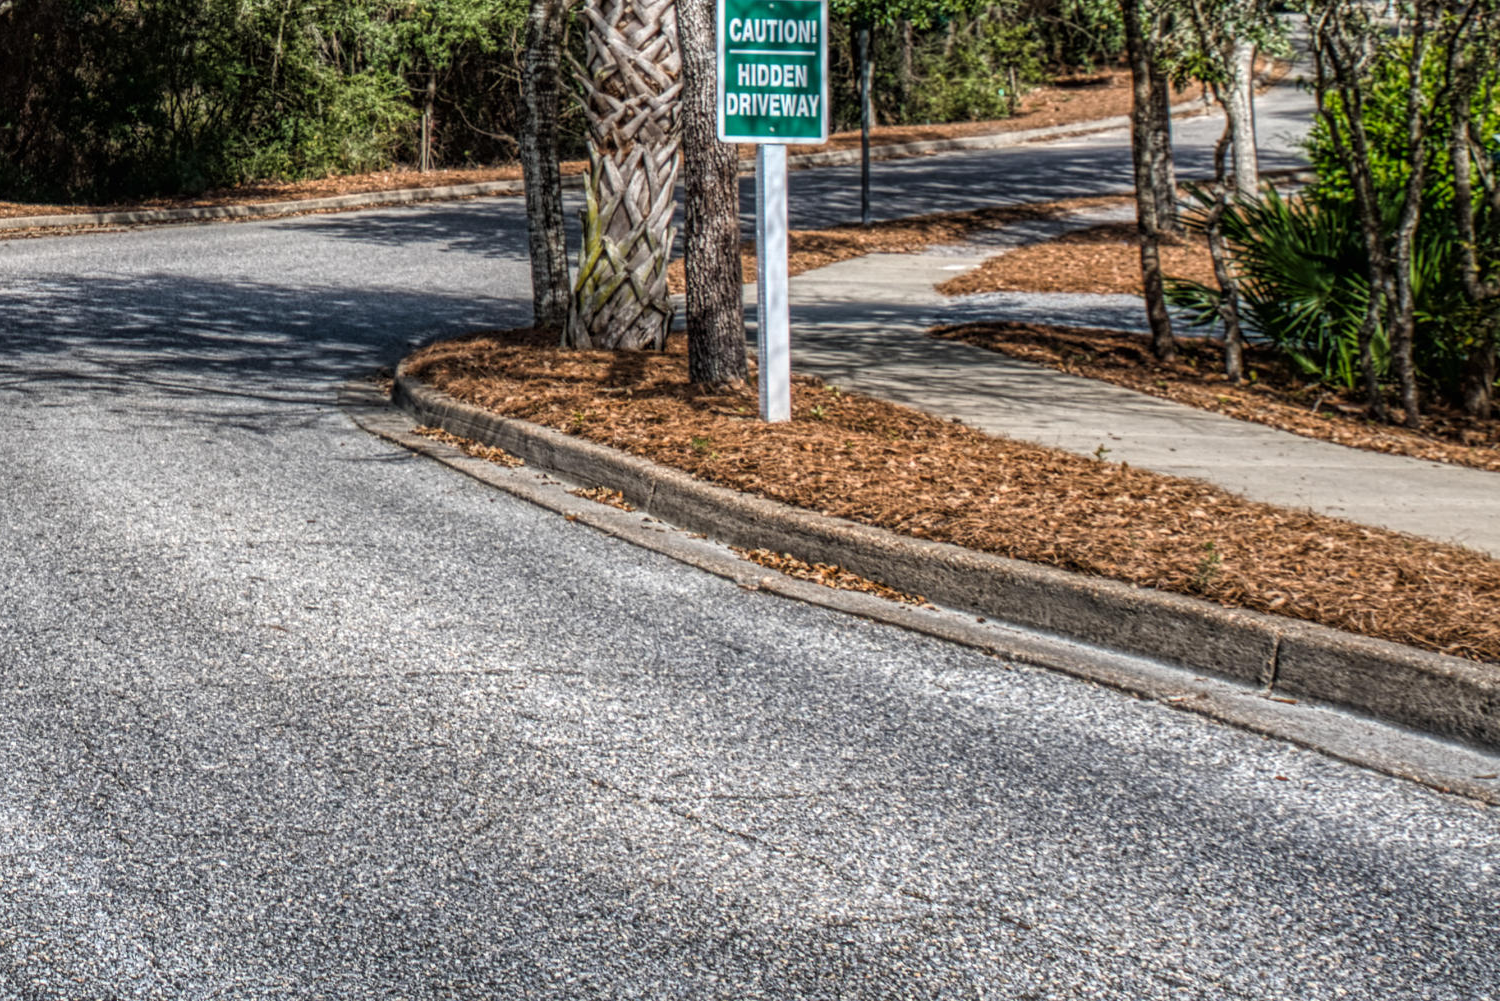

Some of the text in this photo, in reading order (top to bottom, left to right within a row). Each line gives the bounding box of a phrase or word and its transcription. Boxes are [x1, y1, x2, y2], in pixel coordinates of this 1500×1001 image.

[729, 18, 817, 43] CAUTION!
[738, 63, 807, 87] HIDDEN
[726, 93, 819, 117] DRIVEWAY
